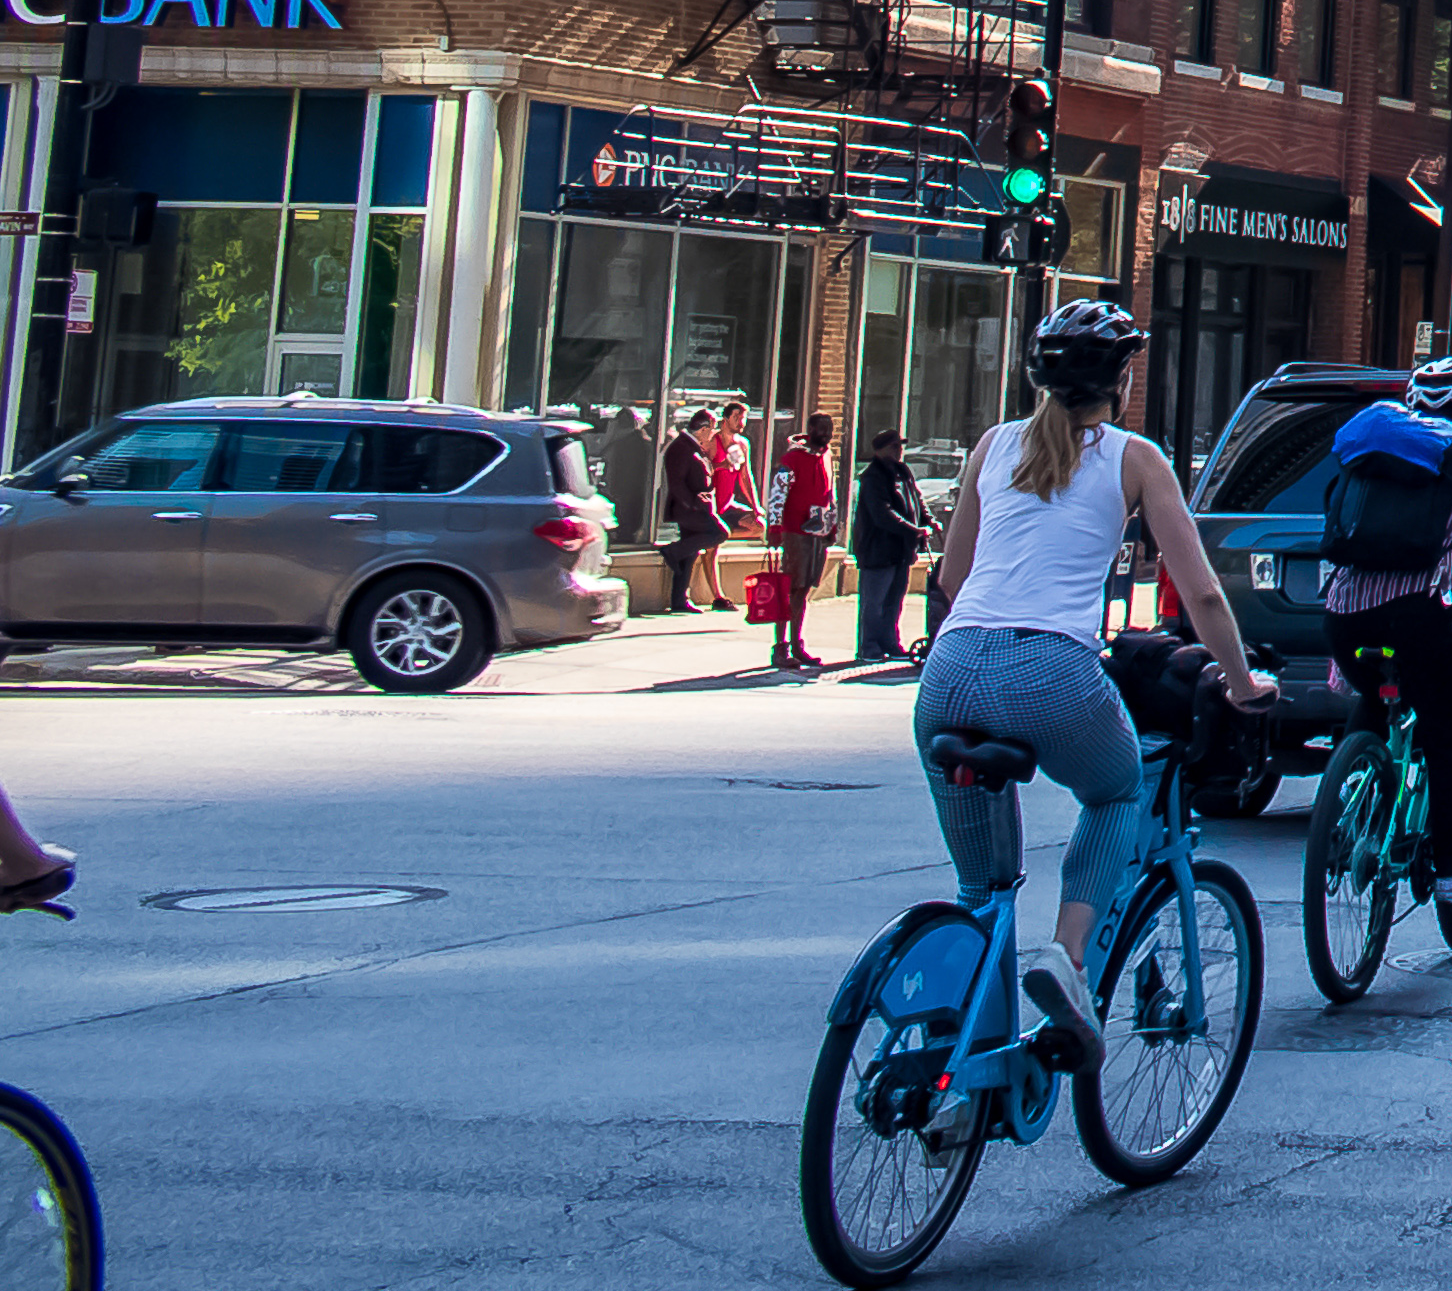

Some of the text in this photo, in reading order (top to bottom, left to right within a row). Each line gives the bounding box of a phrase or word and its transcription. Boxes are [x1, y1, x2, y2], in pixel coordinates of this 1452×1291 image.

[1199, 204, 1239, 235] FINE
[1241, 209, 1289, 242] MEN'S
[1291, 216, 1348, 249] SALONS
